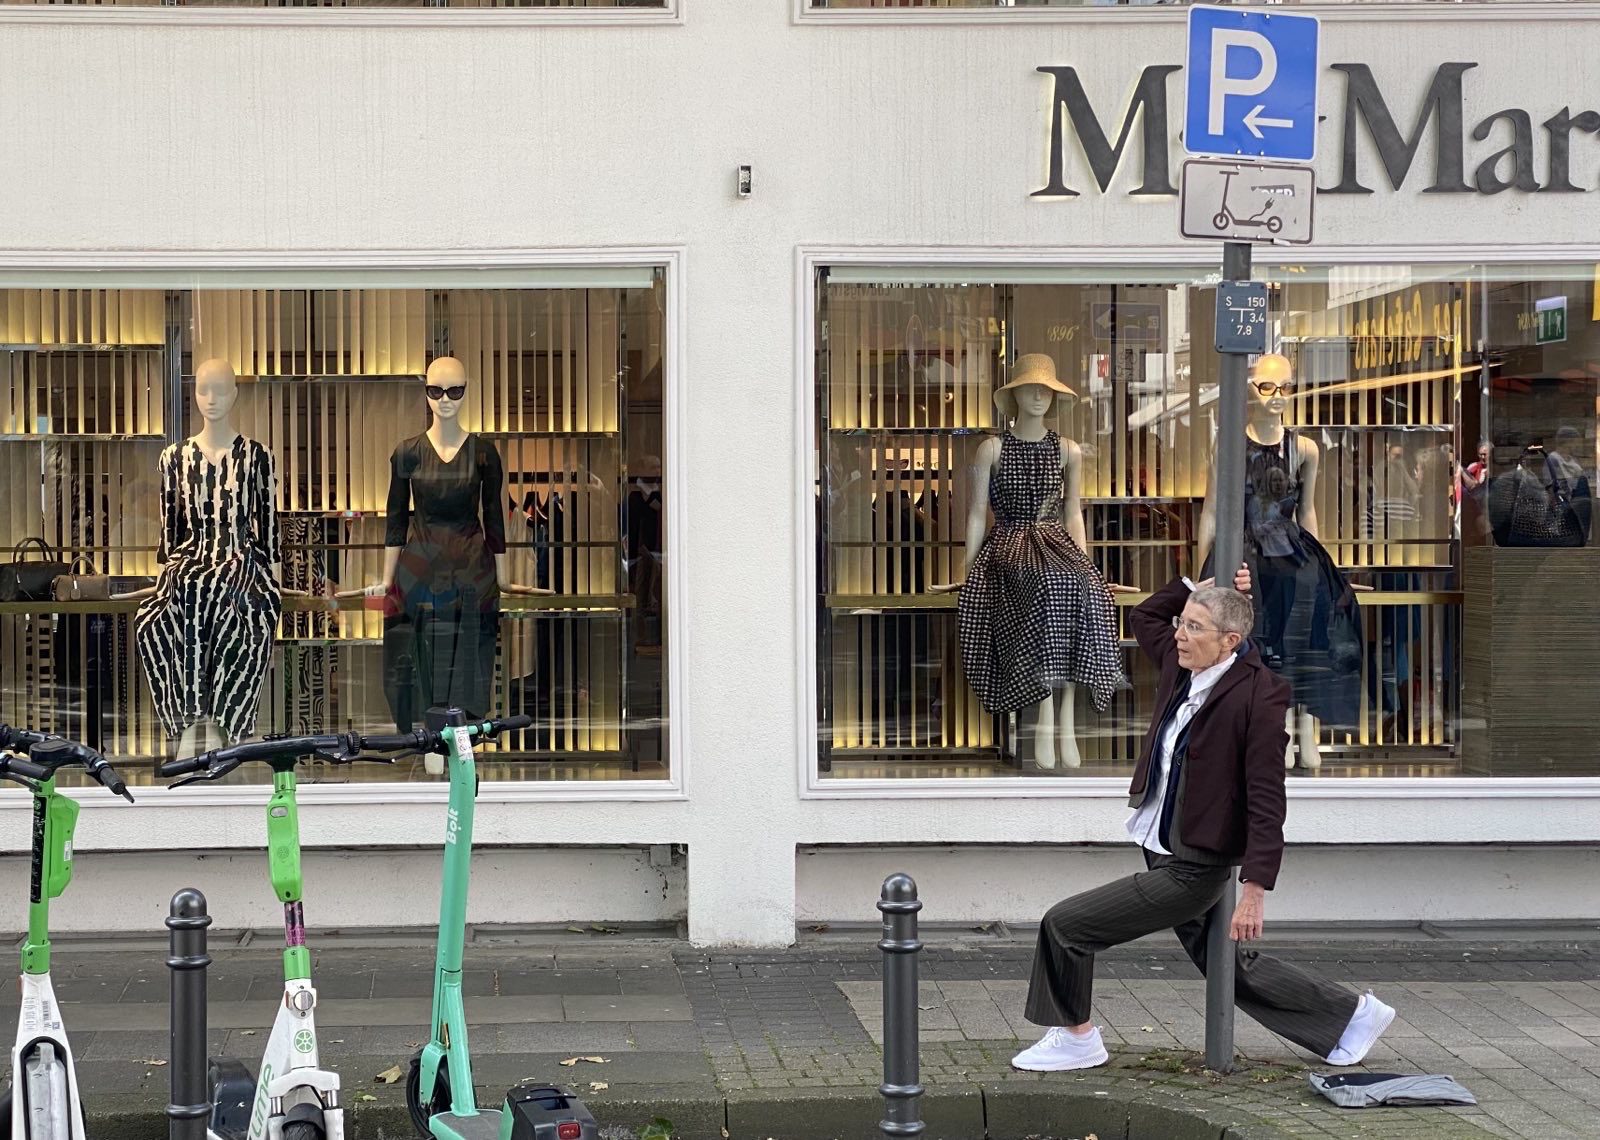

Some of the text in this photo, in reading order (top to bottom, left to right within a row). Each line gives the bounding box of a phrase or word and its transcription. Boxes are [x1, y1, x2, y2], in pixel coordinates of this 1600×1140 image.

[1208, 27, 1278, 136] P
[1316, 62, 1600, 195] Mar
[1225, 295, 1265, 308] S 150
[446, 807, 461, 845] Bolt
